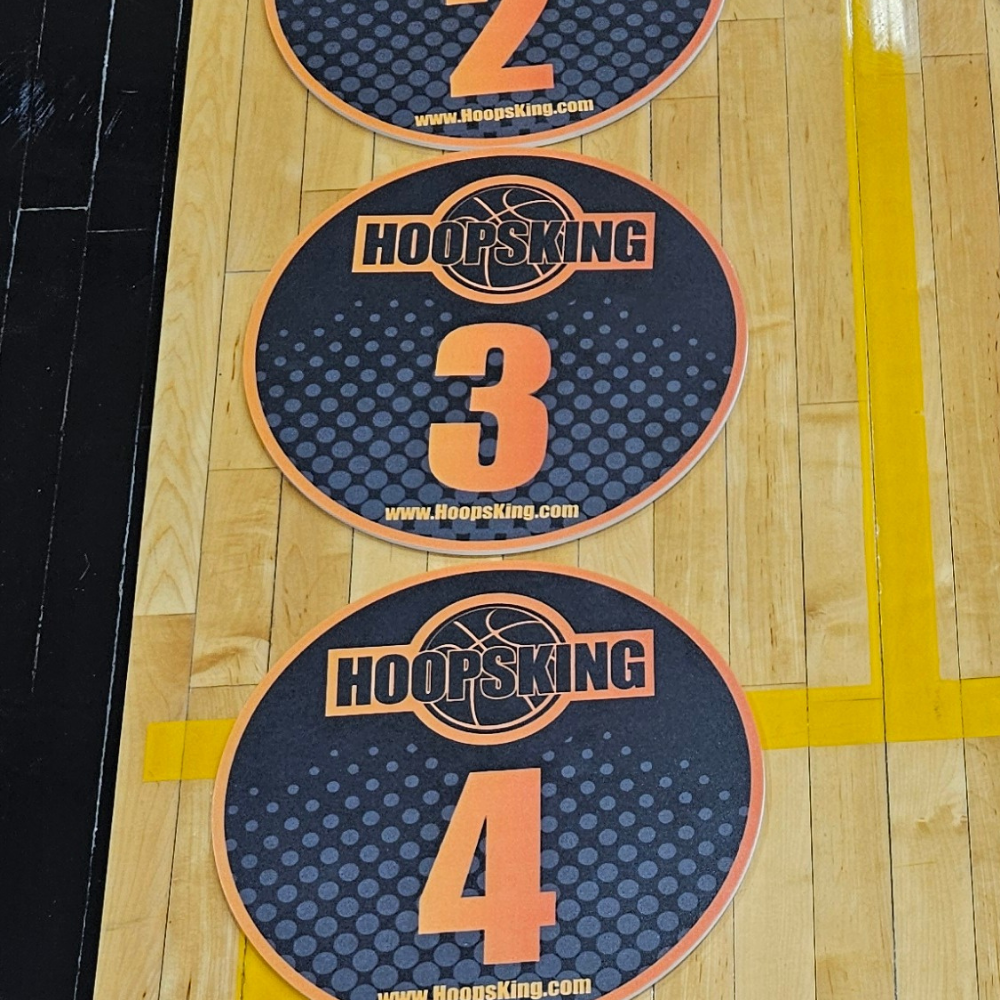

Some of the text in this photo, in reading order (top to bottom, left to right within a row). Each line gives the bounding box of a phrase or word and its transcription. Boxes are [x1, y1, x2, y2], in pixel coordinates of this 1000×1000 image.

[414, 99, 595, 127] www.HoopsKing.com
[362, 219, 648, 267] HOOPSKING
[428, 322, 552, 493] 3
[384, 503, 580, 522] www.HoopsKing.com
[334, 638, 647, 708] HOOPSKING
[417, 767, 557, 966] 4
